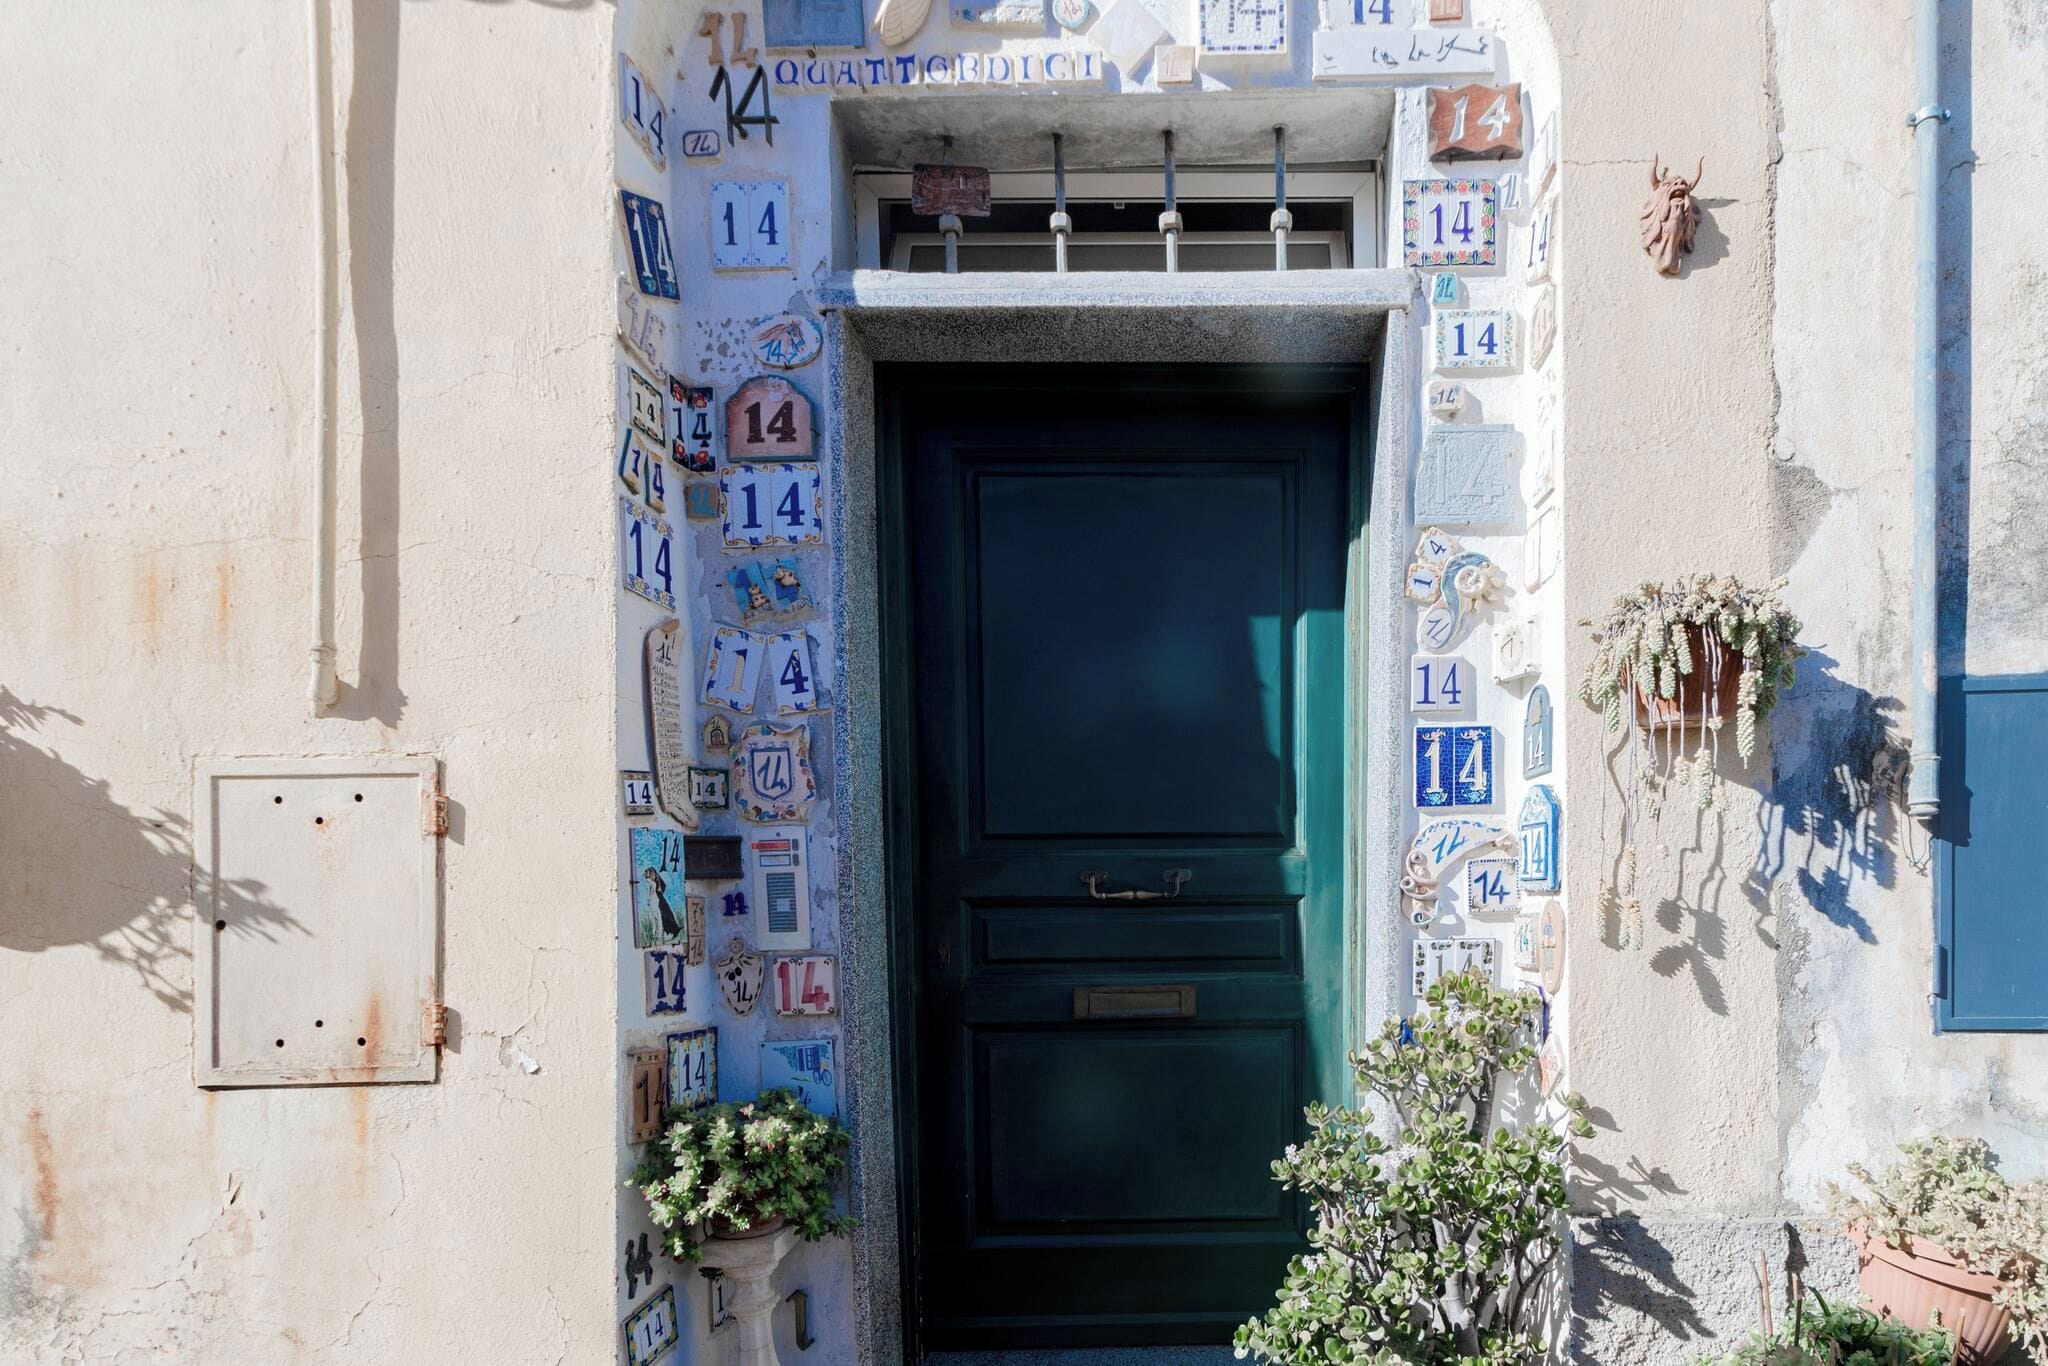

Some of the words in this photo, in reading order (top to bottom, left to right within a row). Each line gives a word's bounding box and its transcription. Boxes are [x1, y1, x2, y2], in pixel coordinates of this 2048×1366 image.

[700, 11, 758, 68] 14
[775, 52, 1093, 85] QUATTORDICI
[632, 76, 664, 156] 14
[709, 65, 780, 148] 14
[1449, 94, 1511, 144] 14
[691, 134, 711, 153] 14
[723, 201, 779, 246] 14
[1428, 200, 1474, 244] 14
[1528, 213, 1549, 268] 14
[633, 213, 676, 283] 14
[760, 340, 782, 362] 14
[1453, 322, 1499, 356] 14
[635, 392, 656, 422] 14
[672, 407, 712, 447] 14
[744, 401, 797, 443] 14
[632, 449, 665, 501] 14
[741, 482, 805, 528] 14
[630, 520, 672, 594] 14
[724, 648, 809, 695] 14
[1416, 663, 1461, 704] 14
[1424, 740, 1487, 793] 14
[1527, 729, 1545, 770] 14
[627, 782, 651, 804] 14
[695, 782, 716, 796] 14
[659, 836, 680, 873] 14
[1432, 826, 1466, 864] 14
[1522, 831, 1544, 875] 14
[723, 892, 748, 917] 14
[1474, 870, 1511, 905] 14
[654, 961, 686, 1000] 14
[733, 980, 752, 1003] 14
[777, 961, 830, 1012] 14
[683, 1052, 706, 1092] 14
[643, 1311, 664, 1348] 14
